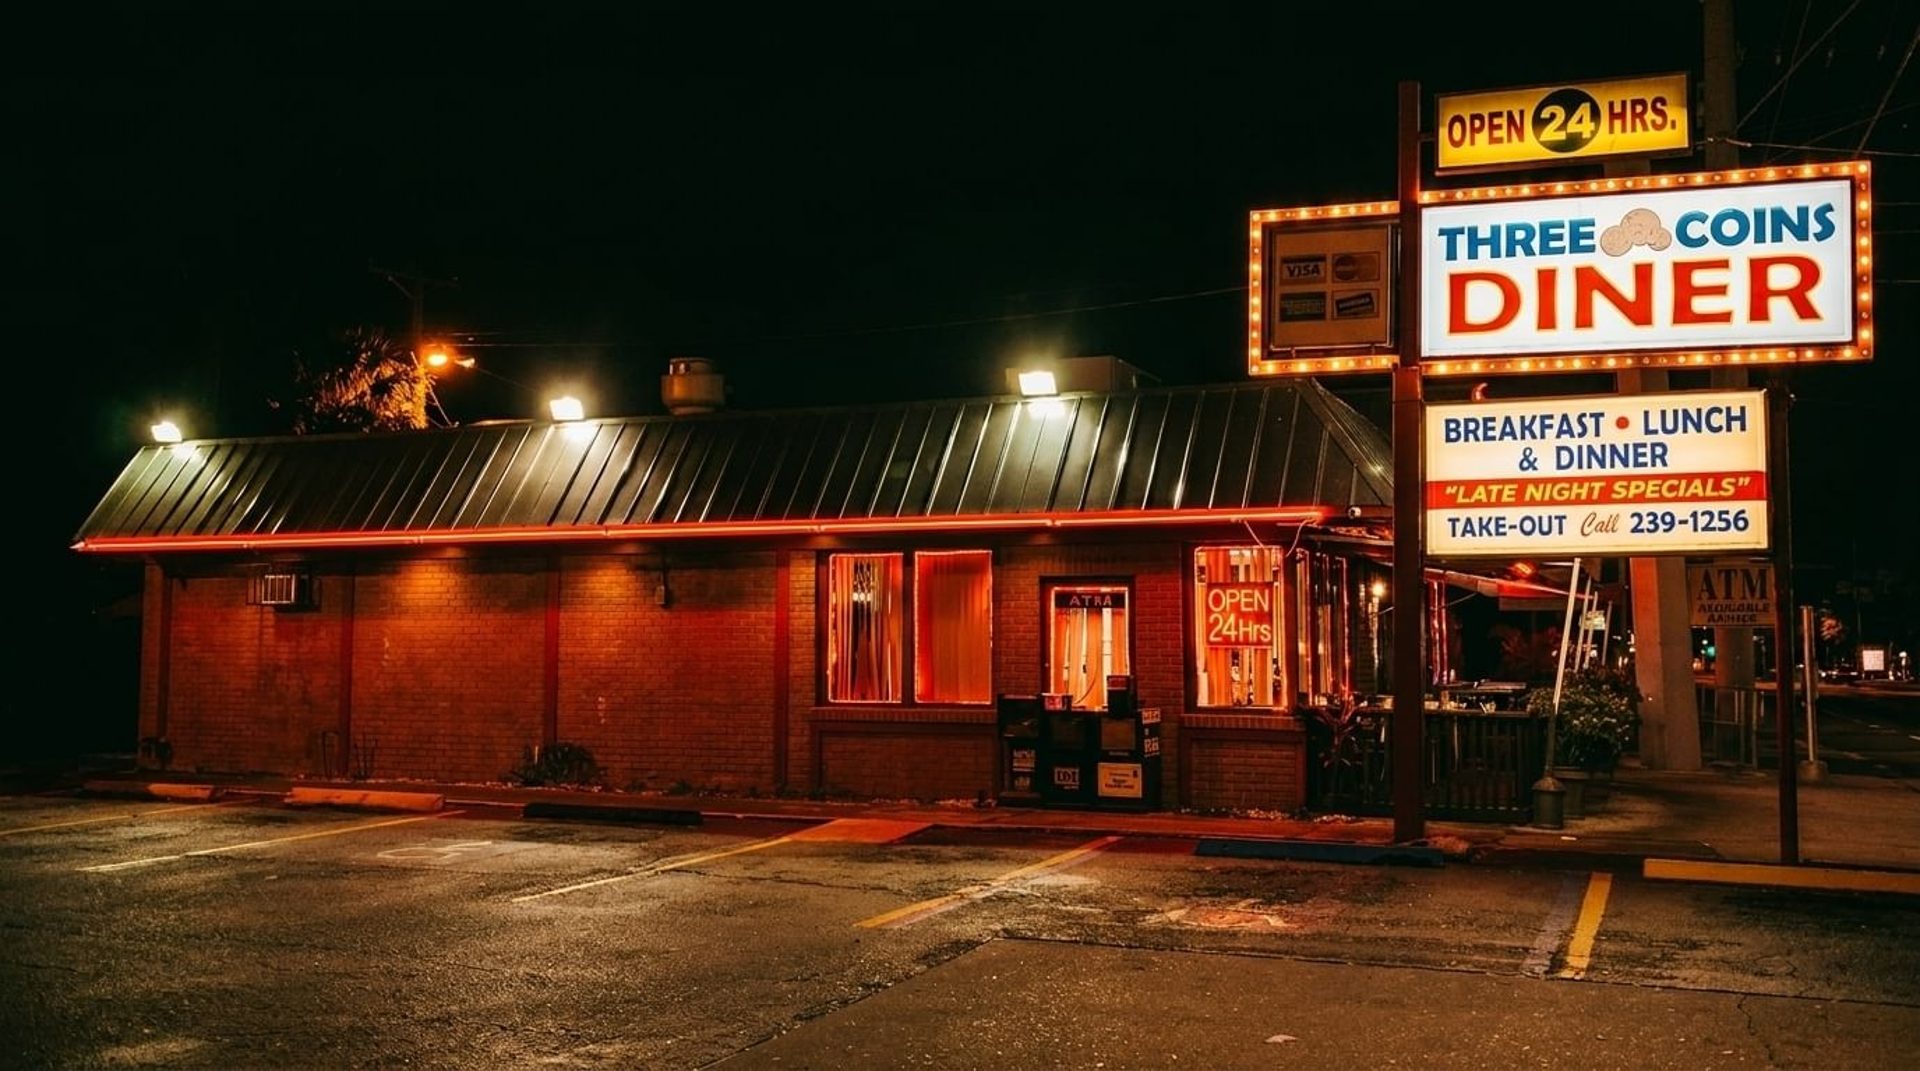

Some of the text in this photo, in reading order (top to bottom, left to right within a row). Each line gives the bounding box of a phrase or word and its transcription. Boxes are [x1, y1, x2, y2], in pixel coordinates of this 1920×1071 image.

[1447, 96, 1677, 148] OPEN 24 HRS.
[1438, 203, 1836, 262] THREE COINS
[1286, 264, 1321, 278] VISA
[1447, 254, 1823, 336] DINER
[1444, 405, 1747, 443] BREAKFAST LUNCH
[1519, 441, 1668, 471] & DINNER
[1524, 481, 1605, 502] NIGHT
[1447, 509, 1749, 538] TAKE-OUT Call 239-1256
[1696, 568, 1768, 600] ATM
[1208, 589, 1270, 612] OPEN
[1209, 613, 1272, 643] 24Hrs
